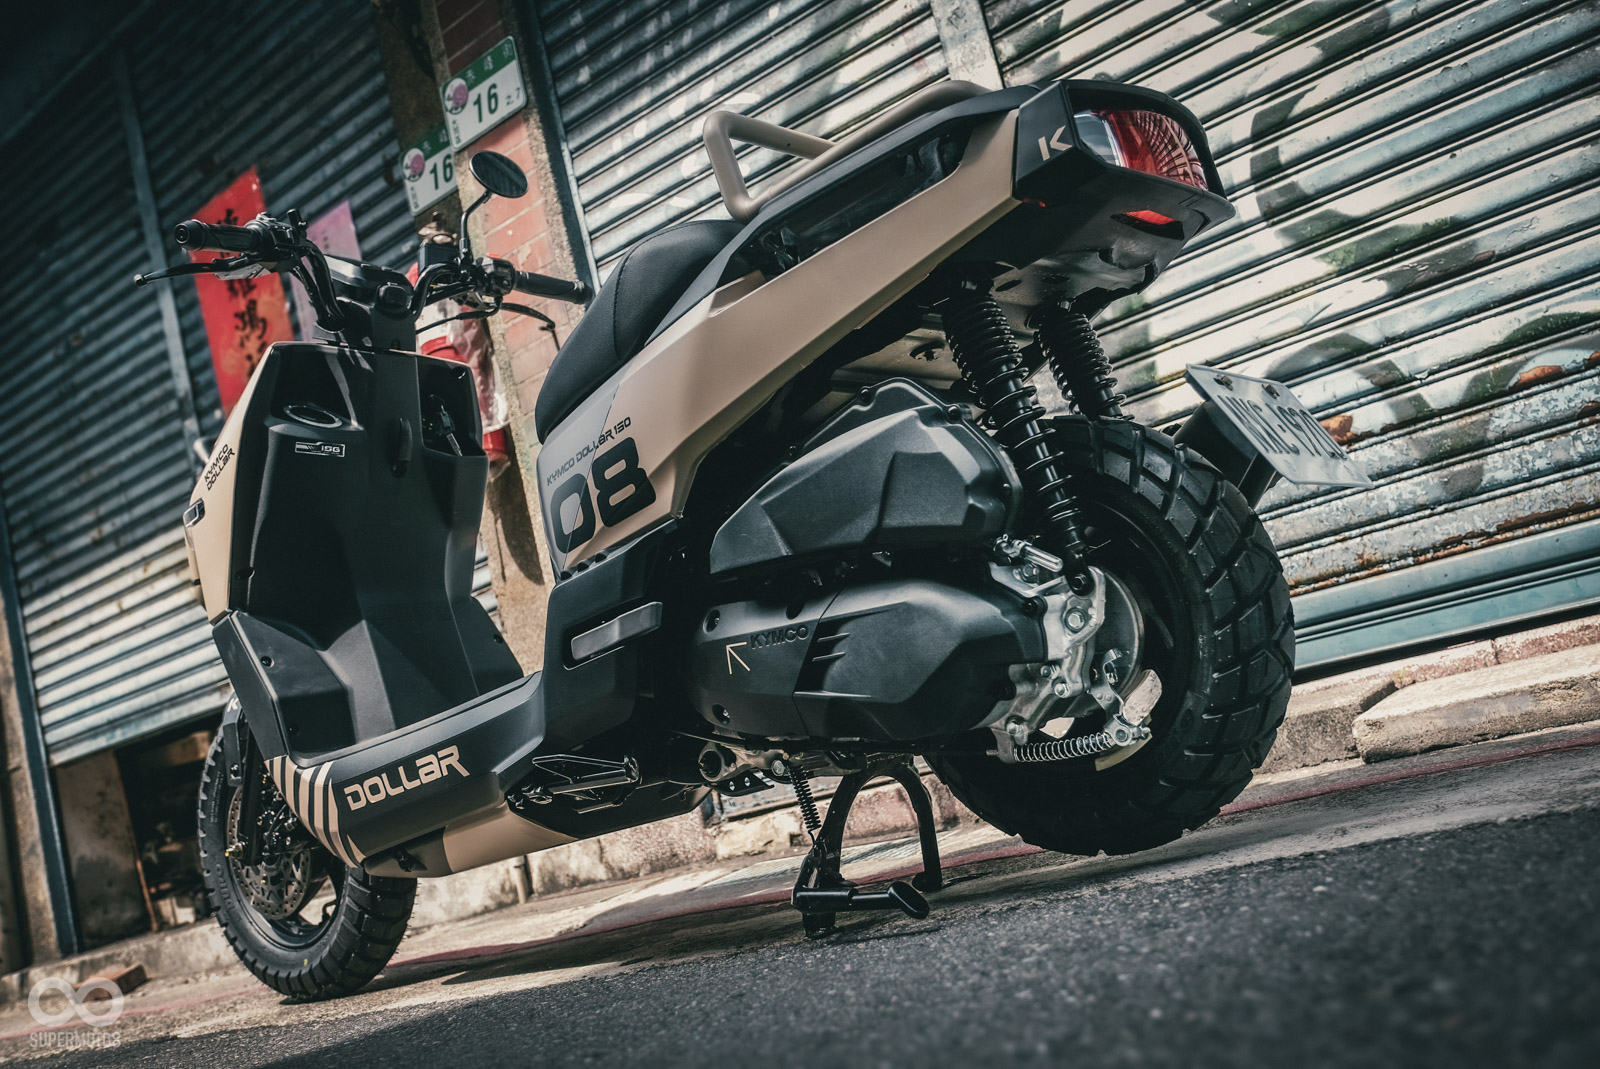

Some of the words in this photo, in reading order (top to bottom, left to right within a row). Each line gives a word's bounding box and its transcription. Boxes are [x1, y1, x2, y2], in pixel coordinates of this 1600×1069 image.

[473, 83, 499, 123] 16
[429, 154, 453, 191] 16
[204, 443, 229, 482] KYMCO
[546, 458, 575, 487] KYMCO
[613, 416, 632, 435] 150
[550, 436, 657, 554] 08
[750, 624, 808, 649] KYMCO
